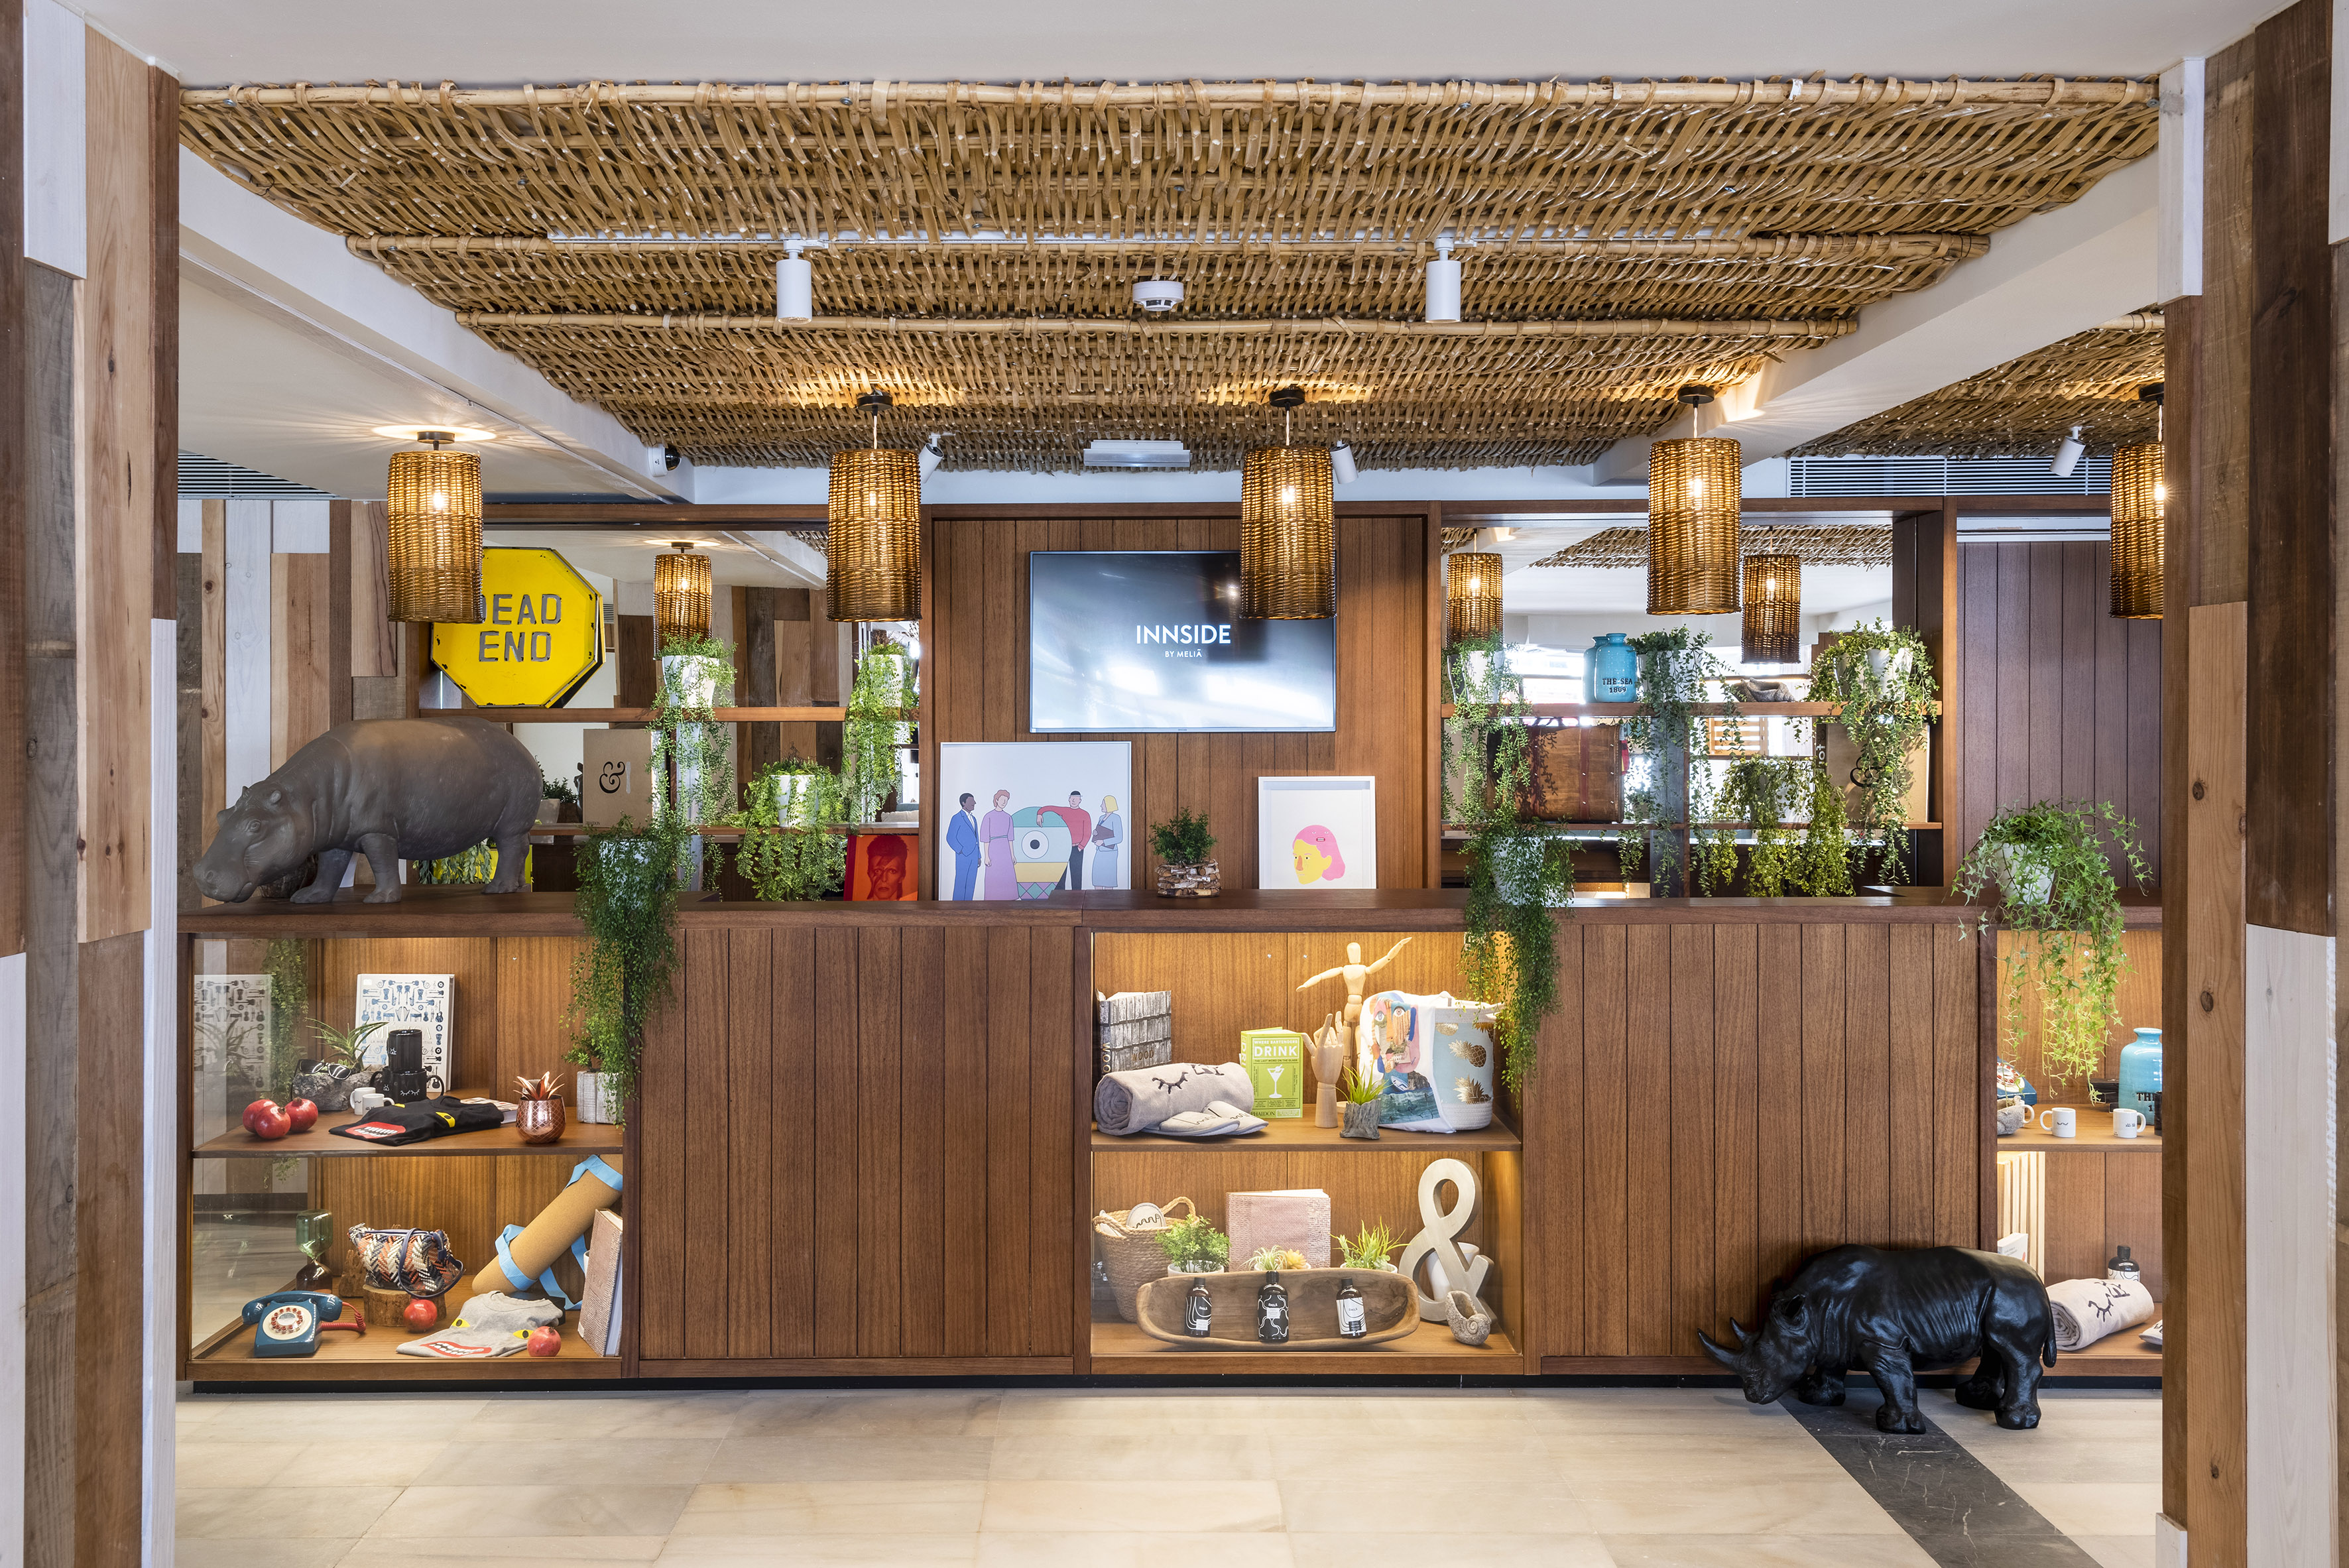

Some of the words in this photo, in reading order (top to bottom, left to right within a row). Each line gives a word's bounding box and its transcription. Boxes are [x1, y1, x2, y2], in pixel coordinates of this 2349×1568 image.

[479, 631, 552, 662] END
[1136, 625, 1231, 644] INNSIDE
[599, 761, 625, 794] &
[1103, 1042, 1111, 1073] WOO
[1132, 1050, 1155, 1061] WOOD
[1254, 1046, 1297, 1057] DRINK
